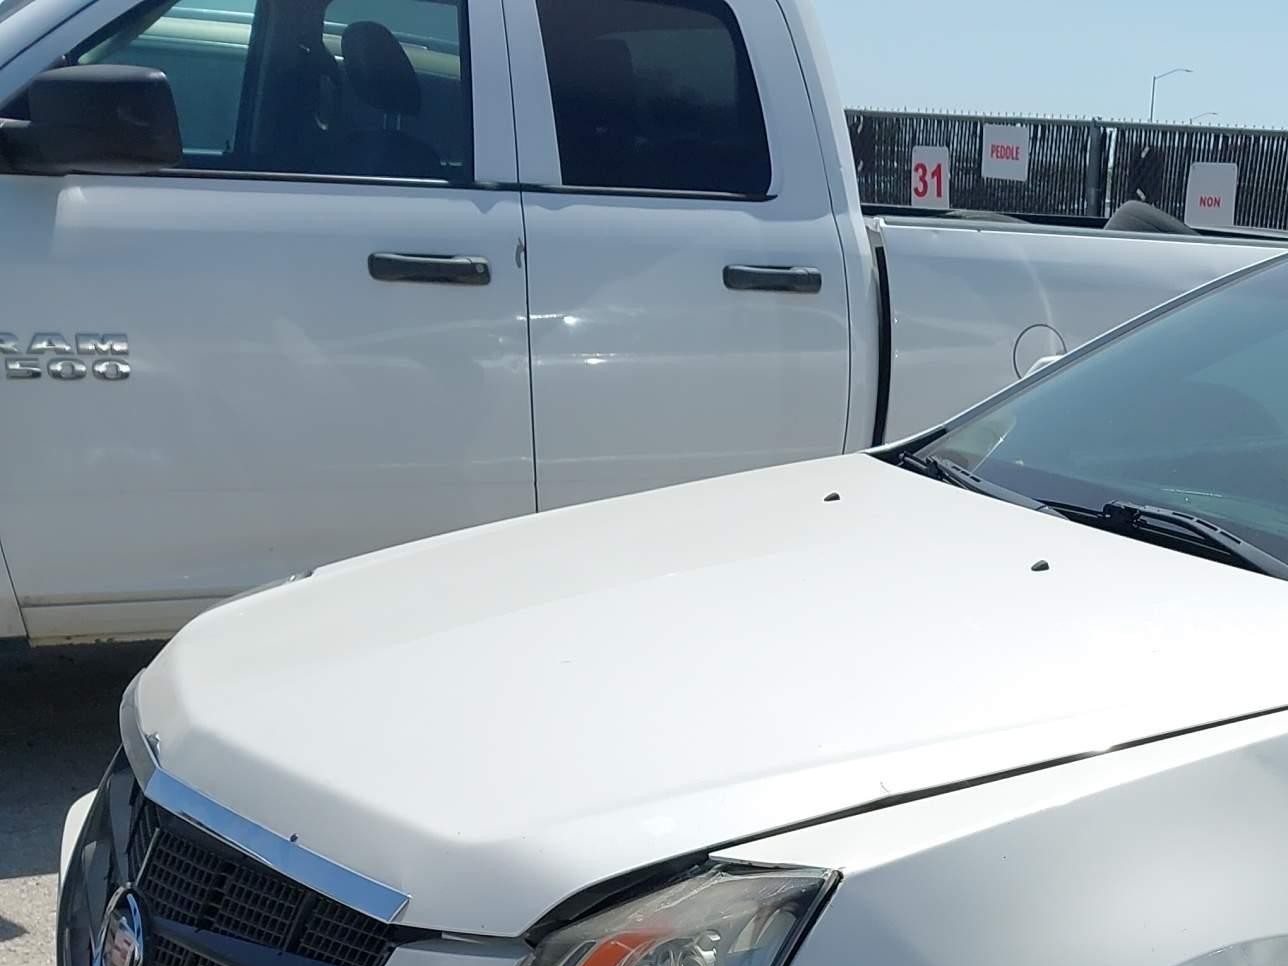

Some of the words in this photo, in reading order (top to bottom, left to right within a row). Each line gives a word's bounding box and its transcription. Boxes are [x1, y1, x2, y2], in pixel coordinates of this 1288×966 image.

[990, 143, 1020, 160] PEDDLE
[914, 163, 942, 198] 31
[1199, 196, 1222, 208] NON
